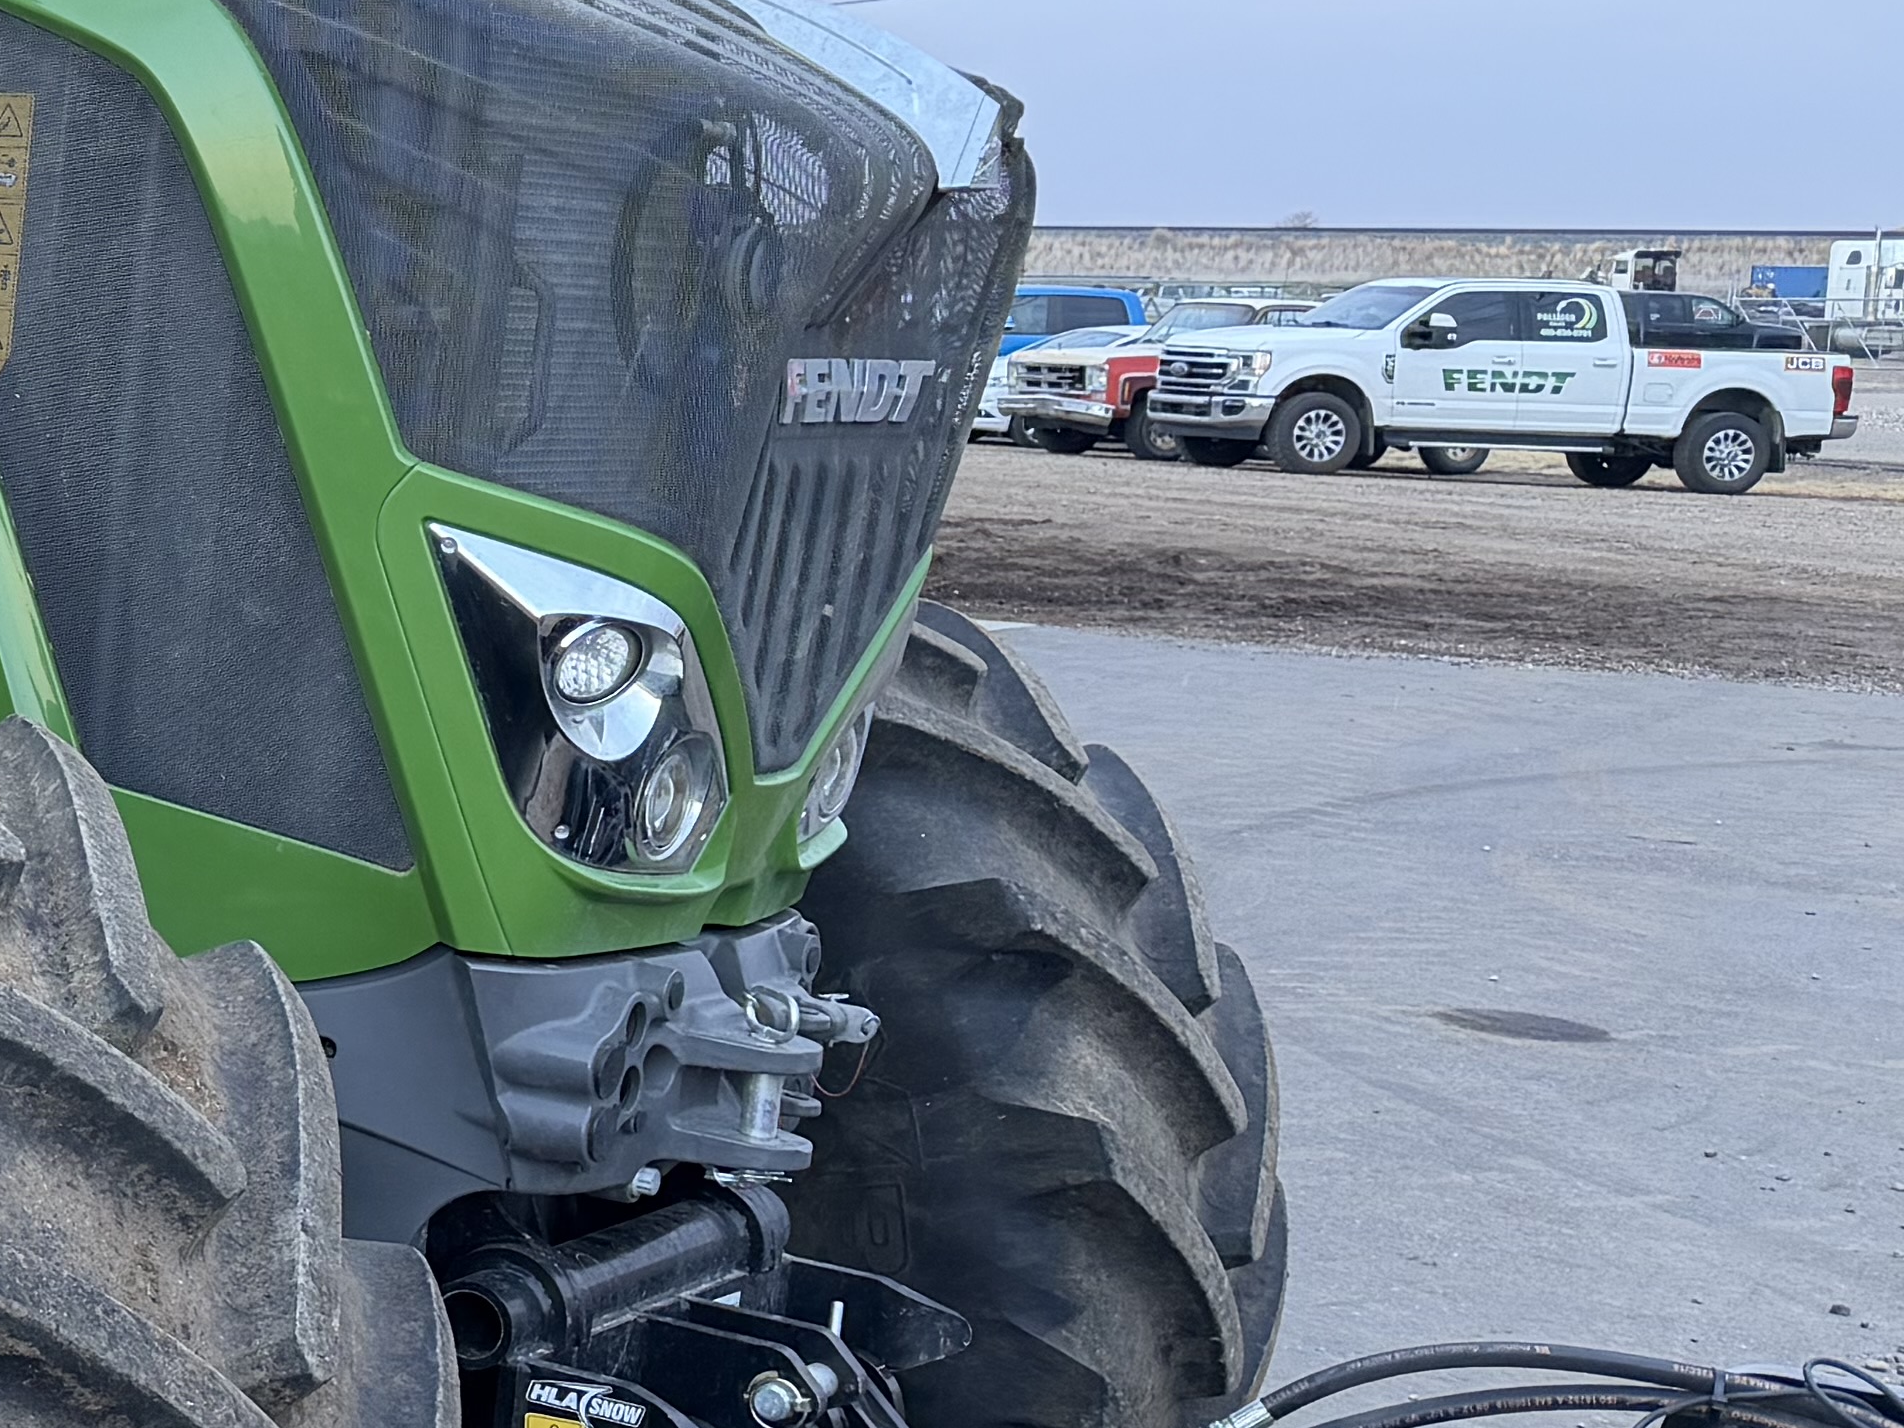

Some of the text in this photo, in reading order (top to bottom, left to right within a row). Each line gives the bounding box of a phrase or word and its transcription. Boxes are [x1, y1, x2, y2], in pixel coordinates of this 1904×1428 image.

[1786, 356, 1825, 370] JCB
[782, 357, 937, 425] FENDT
[1441, 368, 1577, 395] FENDT
[530, 1383, 642, 1424] HLA SNOW
